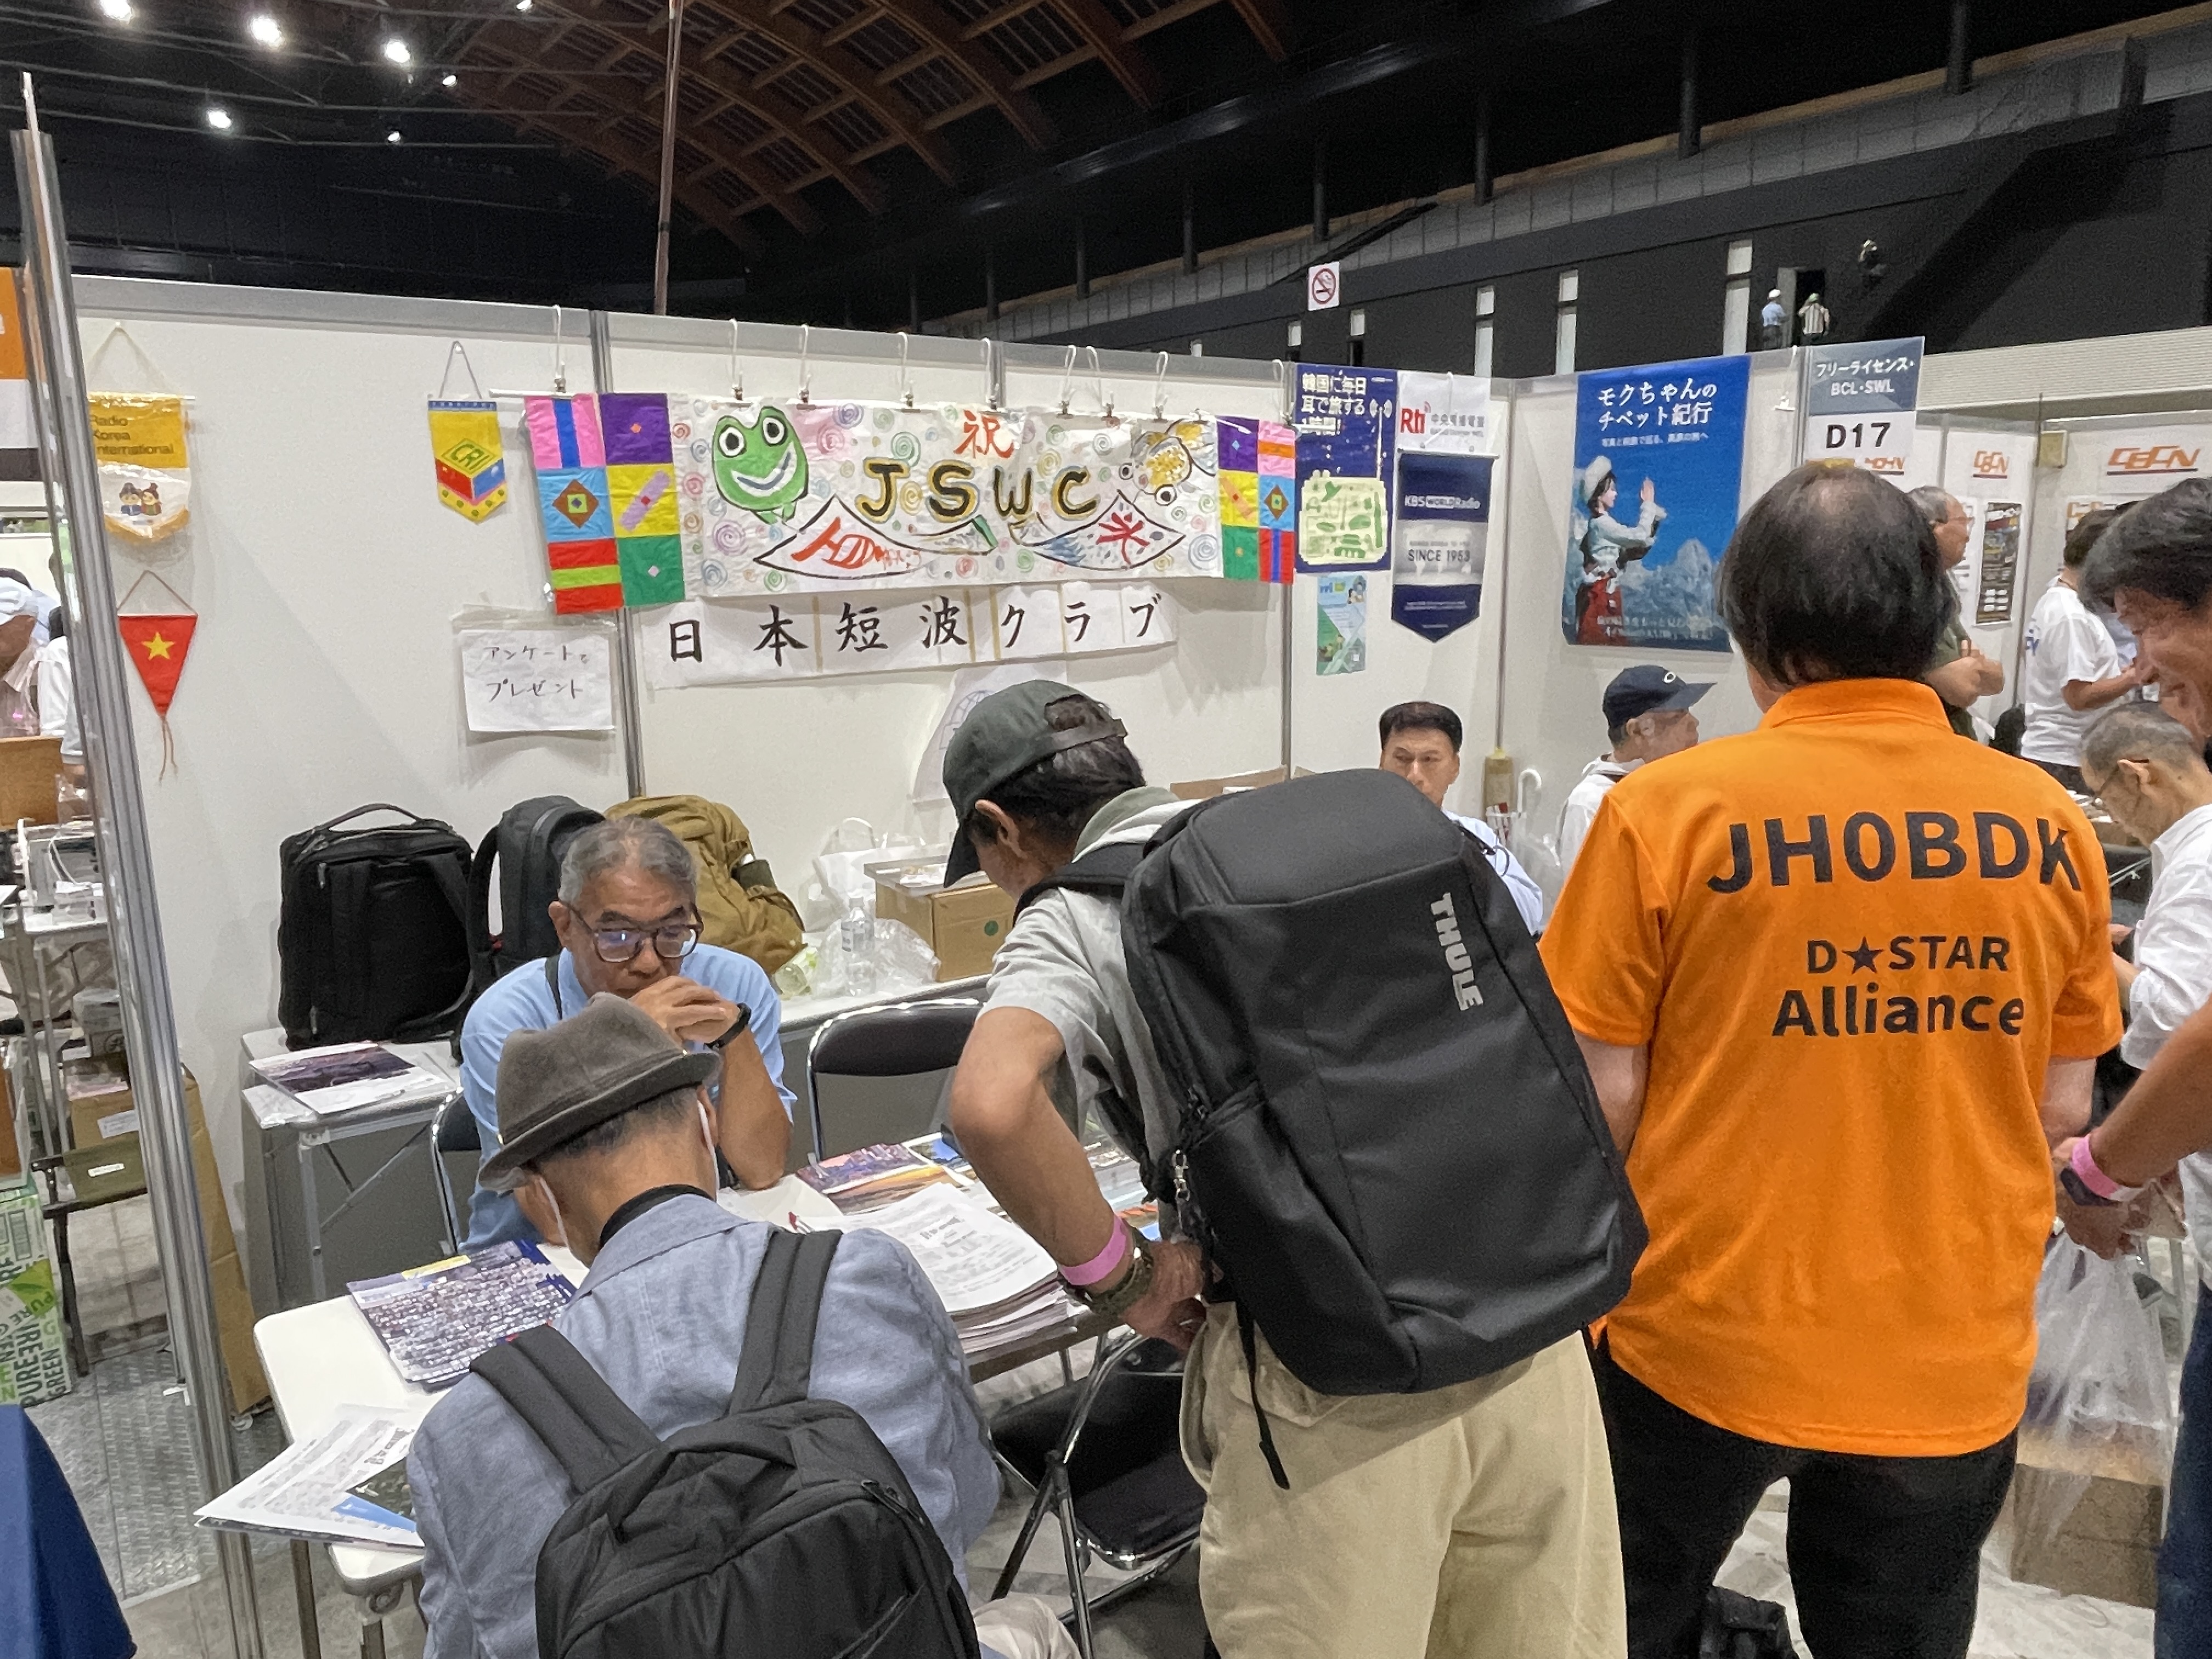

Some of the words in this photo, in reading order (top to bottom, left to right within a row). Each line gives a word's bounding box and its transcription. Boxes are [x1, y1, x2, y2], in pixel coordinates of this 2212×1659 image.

[1598, 377, 1718, 407] モクちゃんの
[955, 410, 1015, 459] 祝
[1826, 422, 1891, 449] D17
[856, 458, 1099, 522] JSWC
[1408, 549, 1442, 562] SINCE
[1446, 549, 1471, 562] 1953
[669, 592, 1162, 667] 日本短波クラブ
[1431, 892, 1483, 1011] THULE
[1771, 981, 2025, 1038] Alliance
